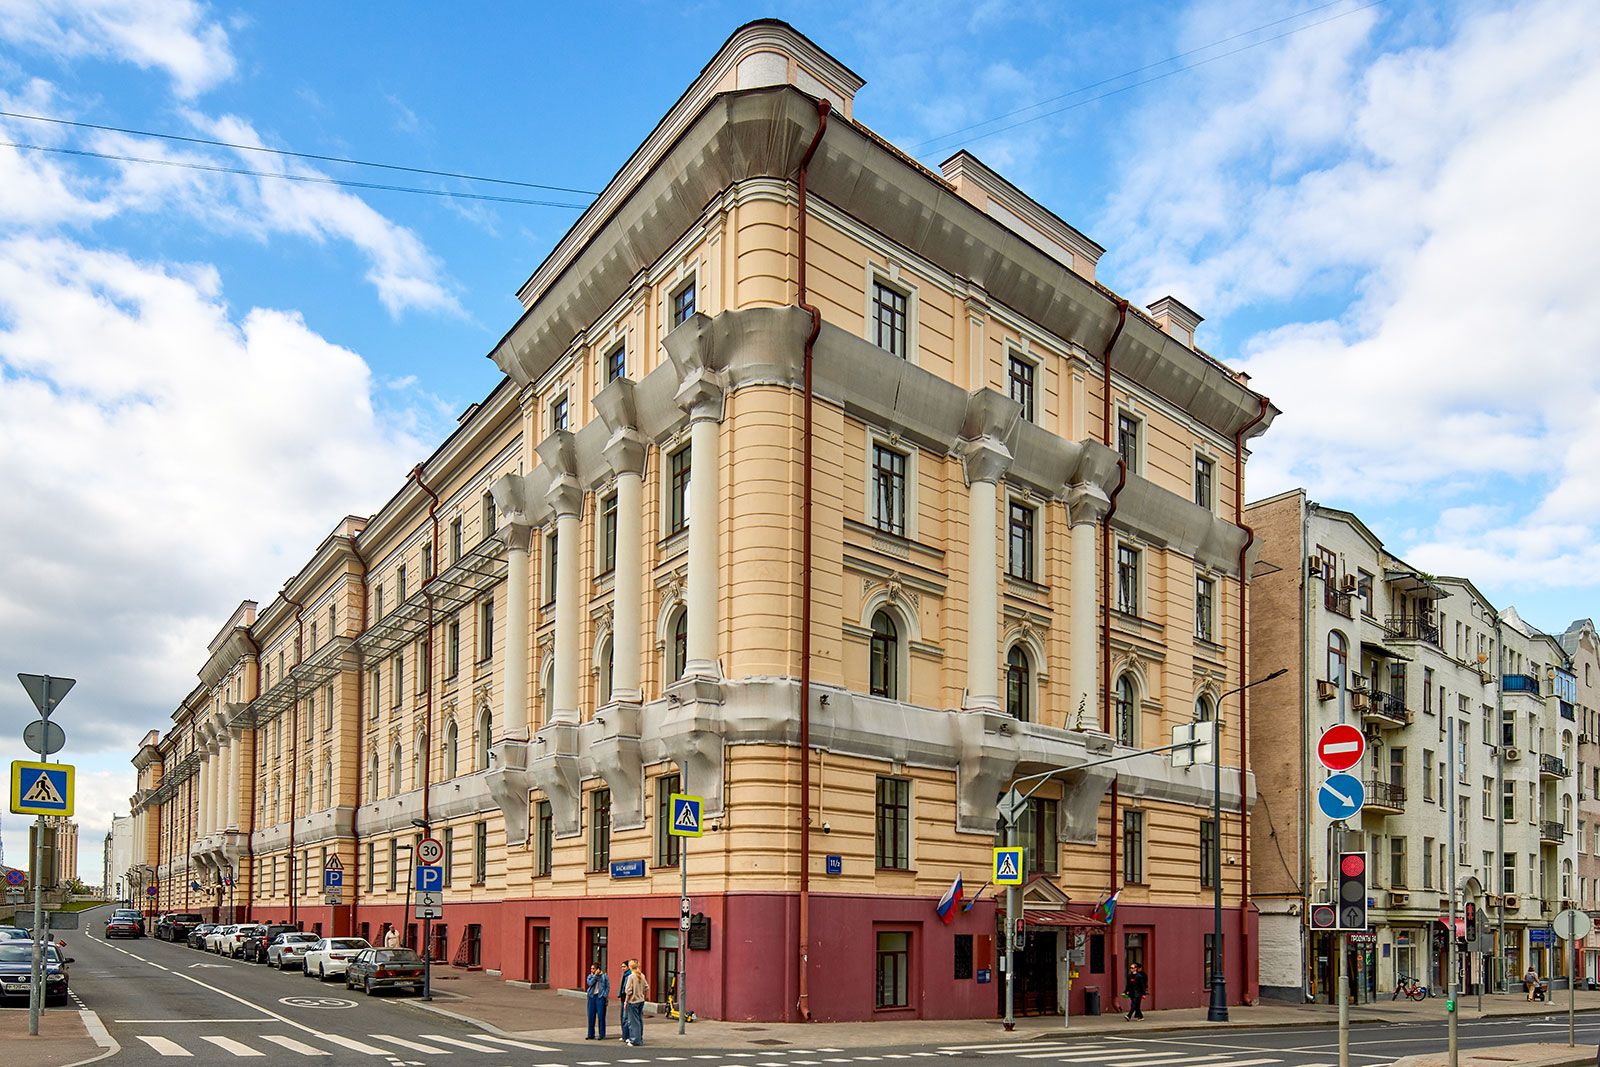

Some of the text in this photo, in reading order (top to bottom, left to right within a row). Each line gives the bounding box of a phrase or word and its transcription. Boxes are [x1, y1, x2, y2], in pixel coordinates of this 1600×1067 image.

[423, 846, 438, 856] 30
[330, 872, 339, 885] P
[423, 869, 438, 889] P
